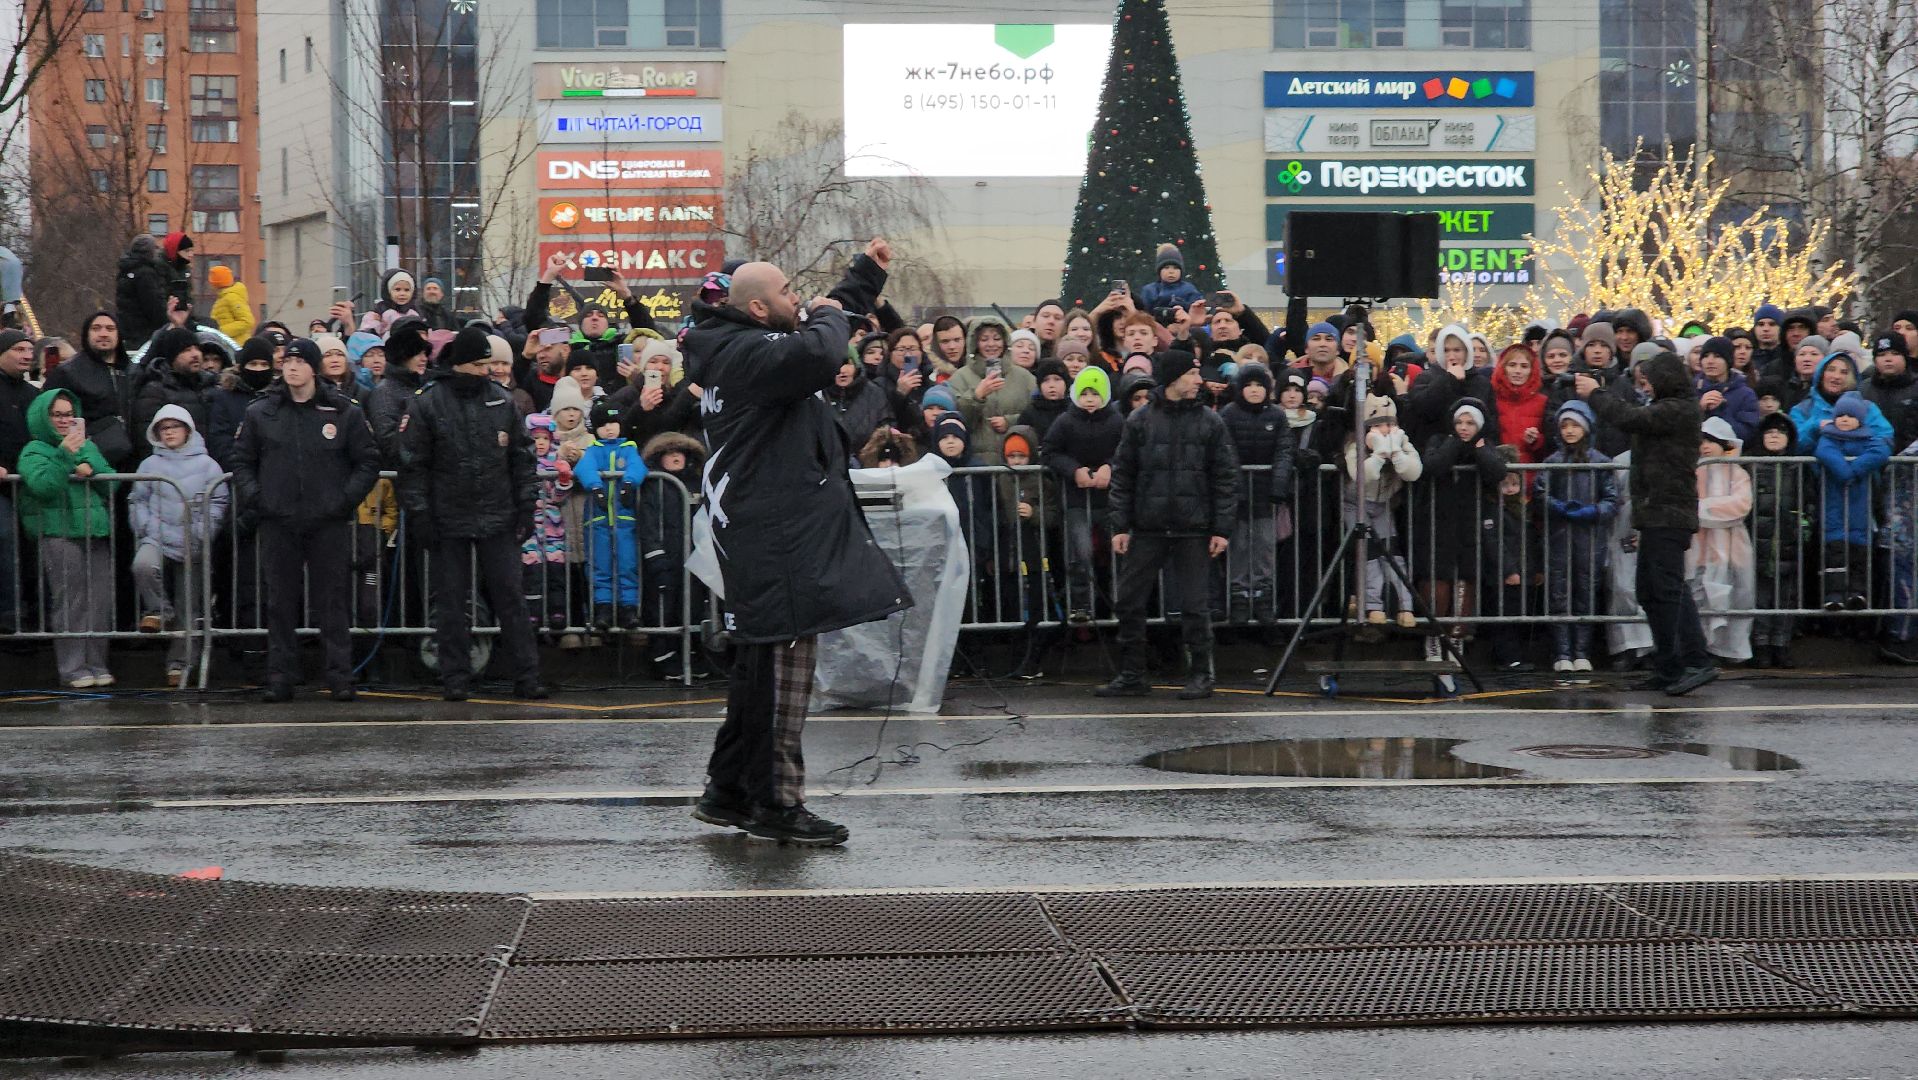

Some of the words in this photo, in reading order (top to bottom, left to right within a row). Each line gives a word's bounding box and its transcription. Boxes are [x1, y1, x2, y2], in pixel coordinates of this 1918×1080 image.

[561, 66, 606, 88] Viva
[643, 66, 698, 88] Roma
[905, 62, 1054, 84] жк-7небо.рф
[1287, 77, 1371, 96] Детский
[1374, 80, 1417, 100] мир
[903, 94, 913, 110] 8
[920, 92, 964, 112] (495)
[970, 94, 1057, 110] 150-01-11
[586, 113, 702, 133] ЧИТАЙ-ГОРОД
[548, 160, 621, 180] DNS
[676, 160, 686, 168] И
[1320, 161, 1526, 194] Перекресток
[584, 207, 655, 222] ЧЕТЫРЕ
[658, 206, 714, 222] ЛАПЫ
[1438, 249, 1528, 271] DENT
